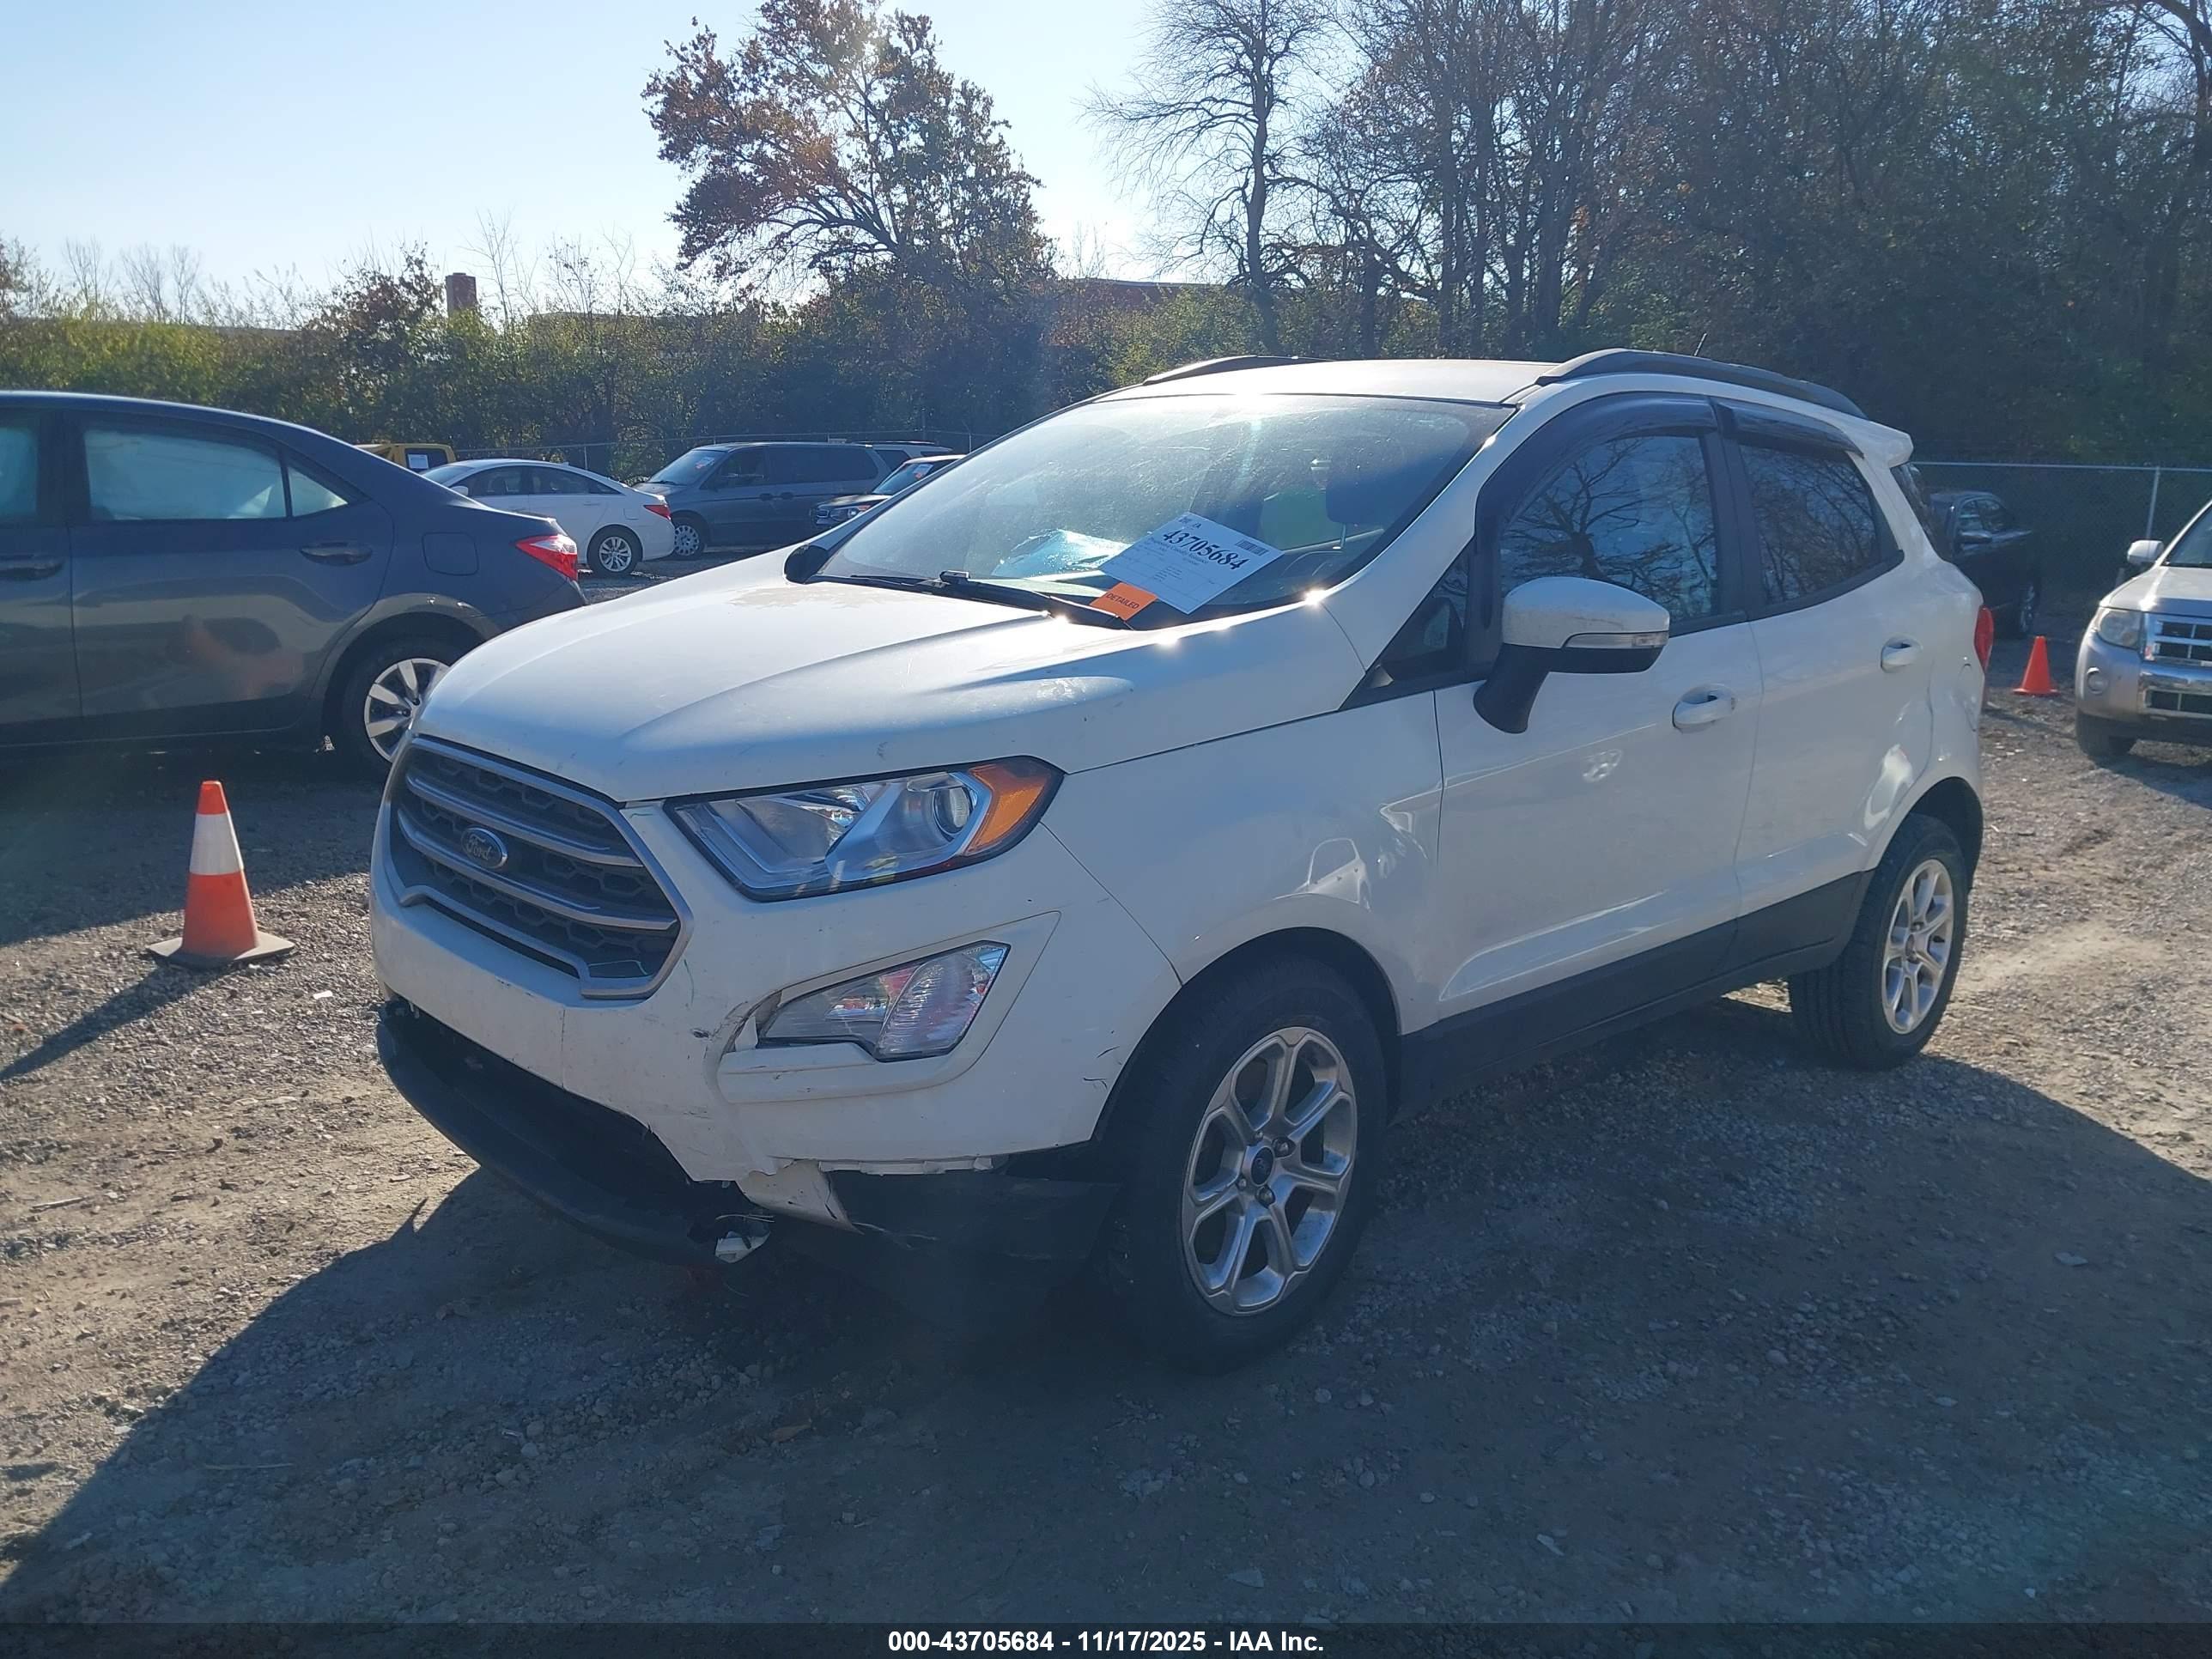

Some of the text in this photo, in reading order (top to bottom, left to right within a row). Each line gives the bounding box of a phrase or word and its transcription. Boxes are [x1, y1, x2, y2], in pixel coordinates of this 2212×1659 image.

[1163, 530, 1251, 569] 43705684
[1106, 592, 1140, 609] DETAILED
[466, 833, 493, 860] Ford
